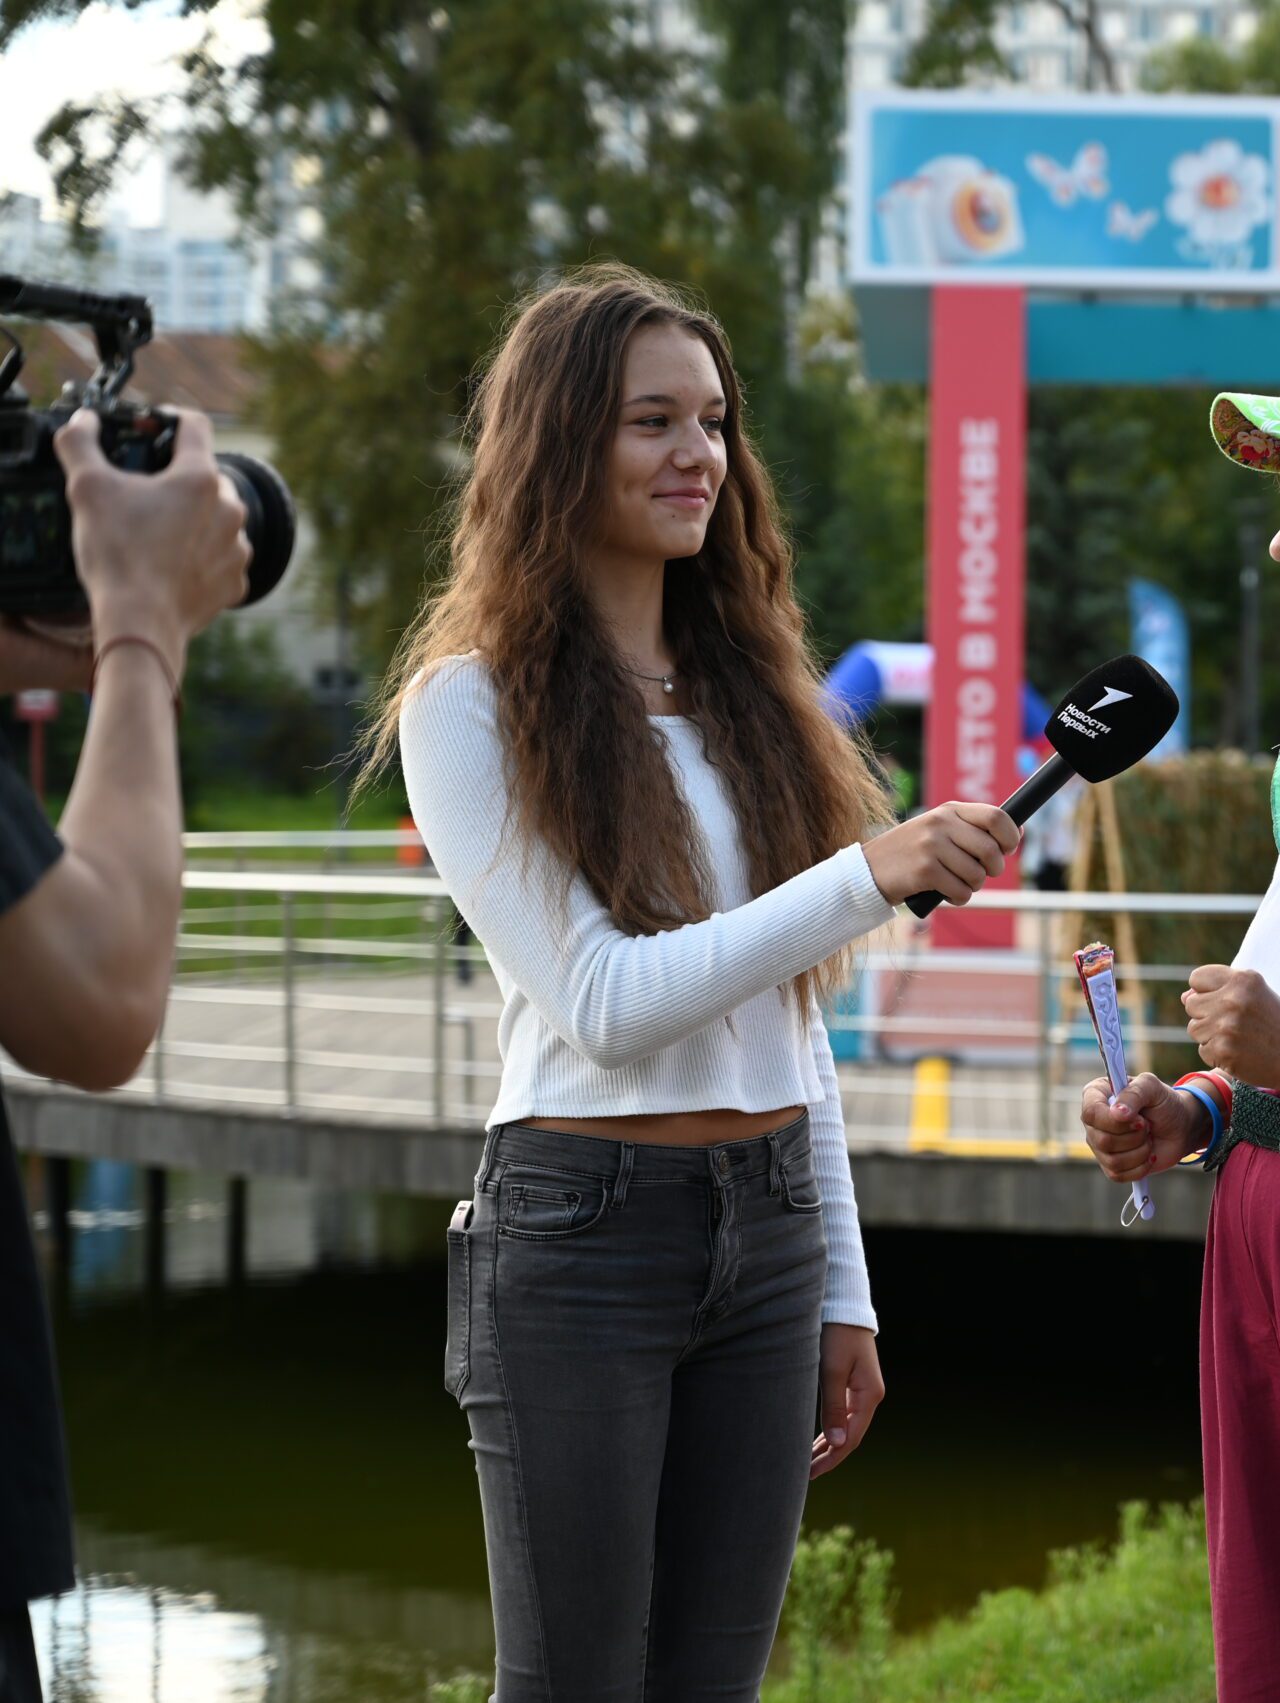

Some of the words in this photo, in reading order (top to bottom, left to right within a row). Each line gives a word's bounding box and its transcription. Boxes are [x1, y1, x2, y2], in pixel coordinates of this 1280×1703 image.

[958, 417, 999, 622] МОСКВЕ
[957, 632, 997, 671] В
[1057, 711, 1099, 739] Первых
[1064, 703, 1112, 734] Новости
